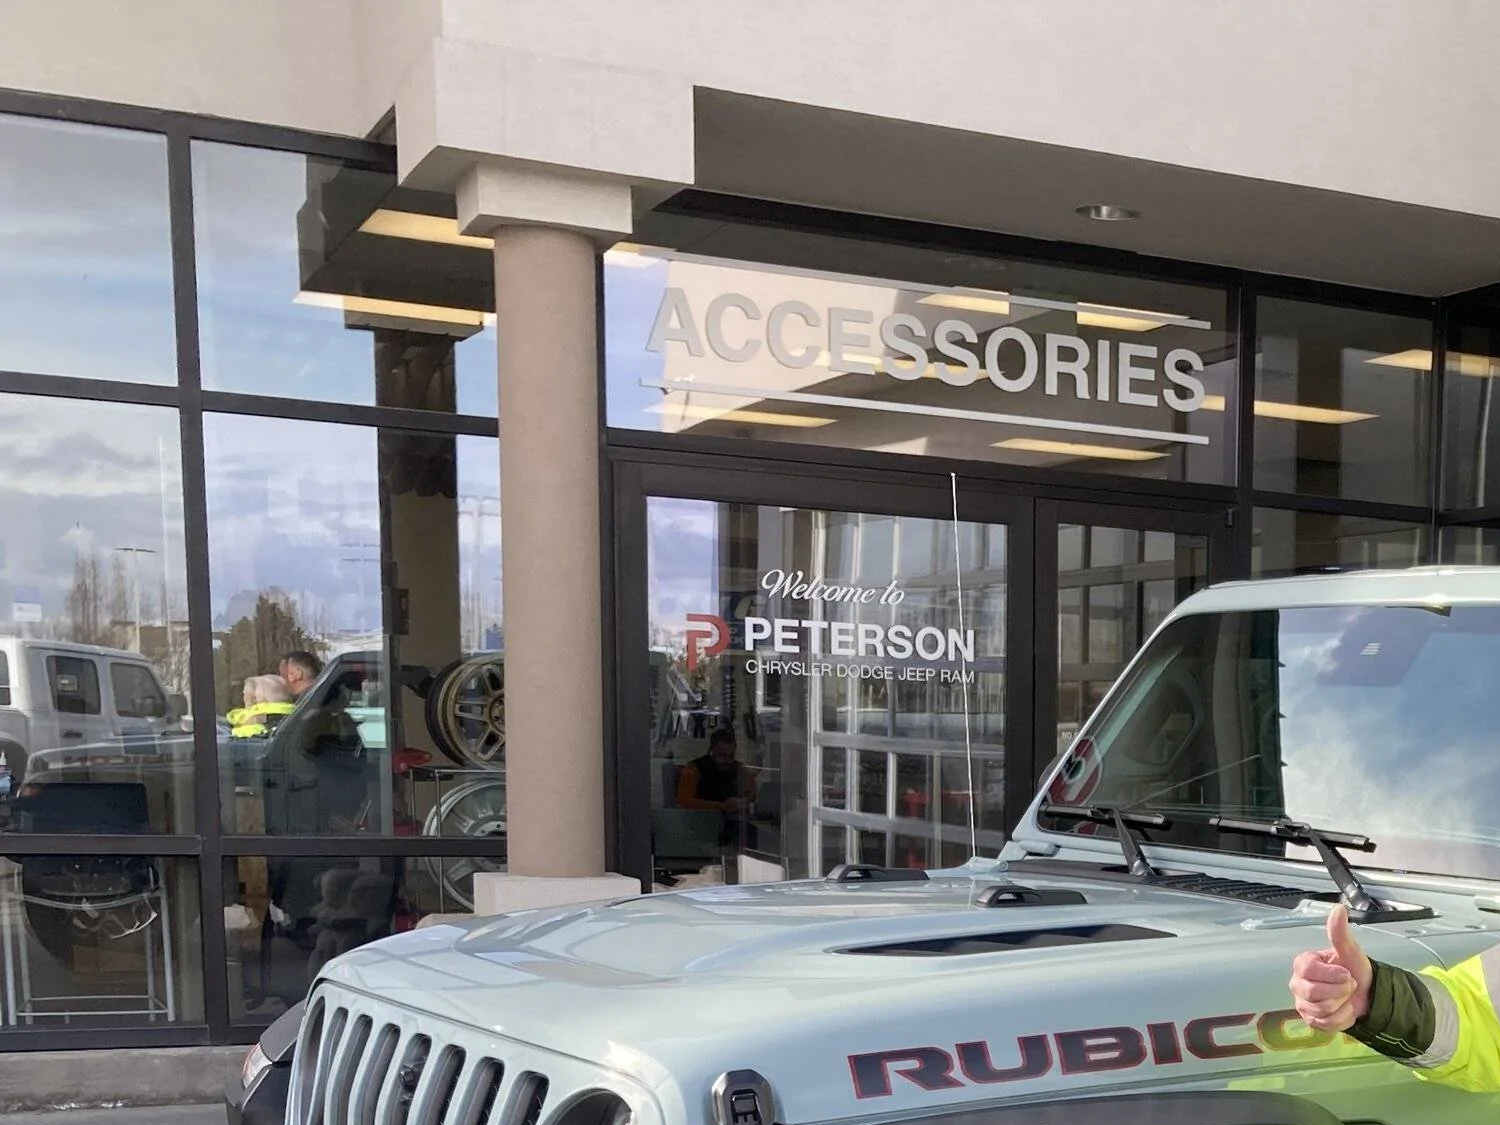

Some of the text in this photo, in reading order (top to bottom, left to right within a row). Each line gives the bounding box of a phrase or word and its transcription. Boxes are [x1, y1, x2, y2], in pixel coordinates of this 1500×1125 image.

[645, 287, 1206, 412] ACCESSORIES
[761, 569, 905, 606] Welcome to
[744, 617, 976, 663] PETERSON
[745, 659, 975, 684] CHRYSLER DODGE JEEP RAM
[848, 1008, 1336, 1099] RUBICO
